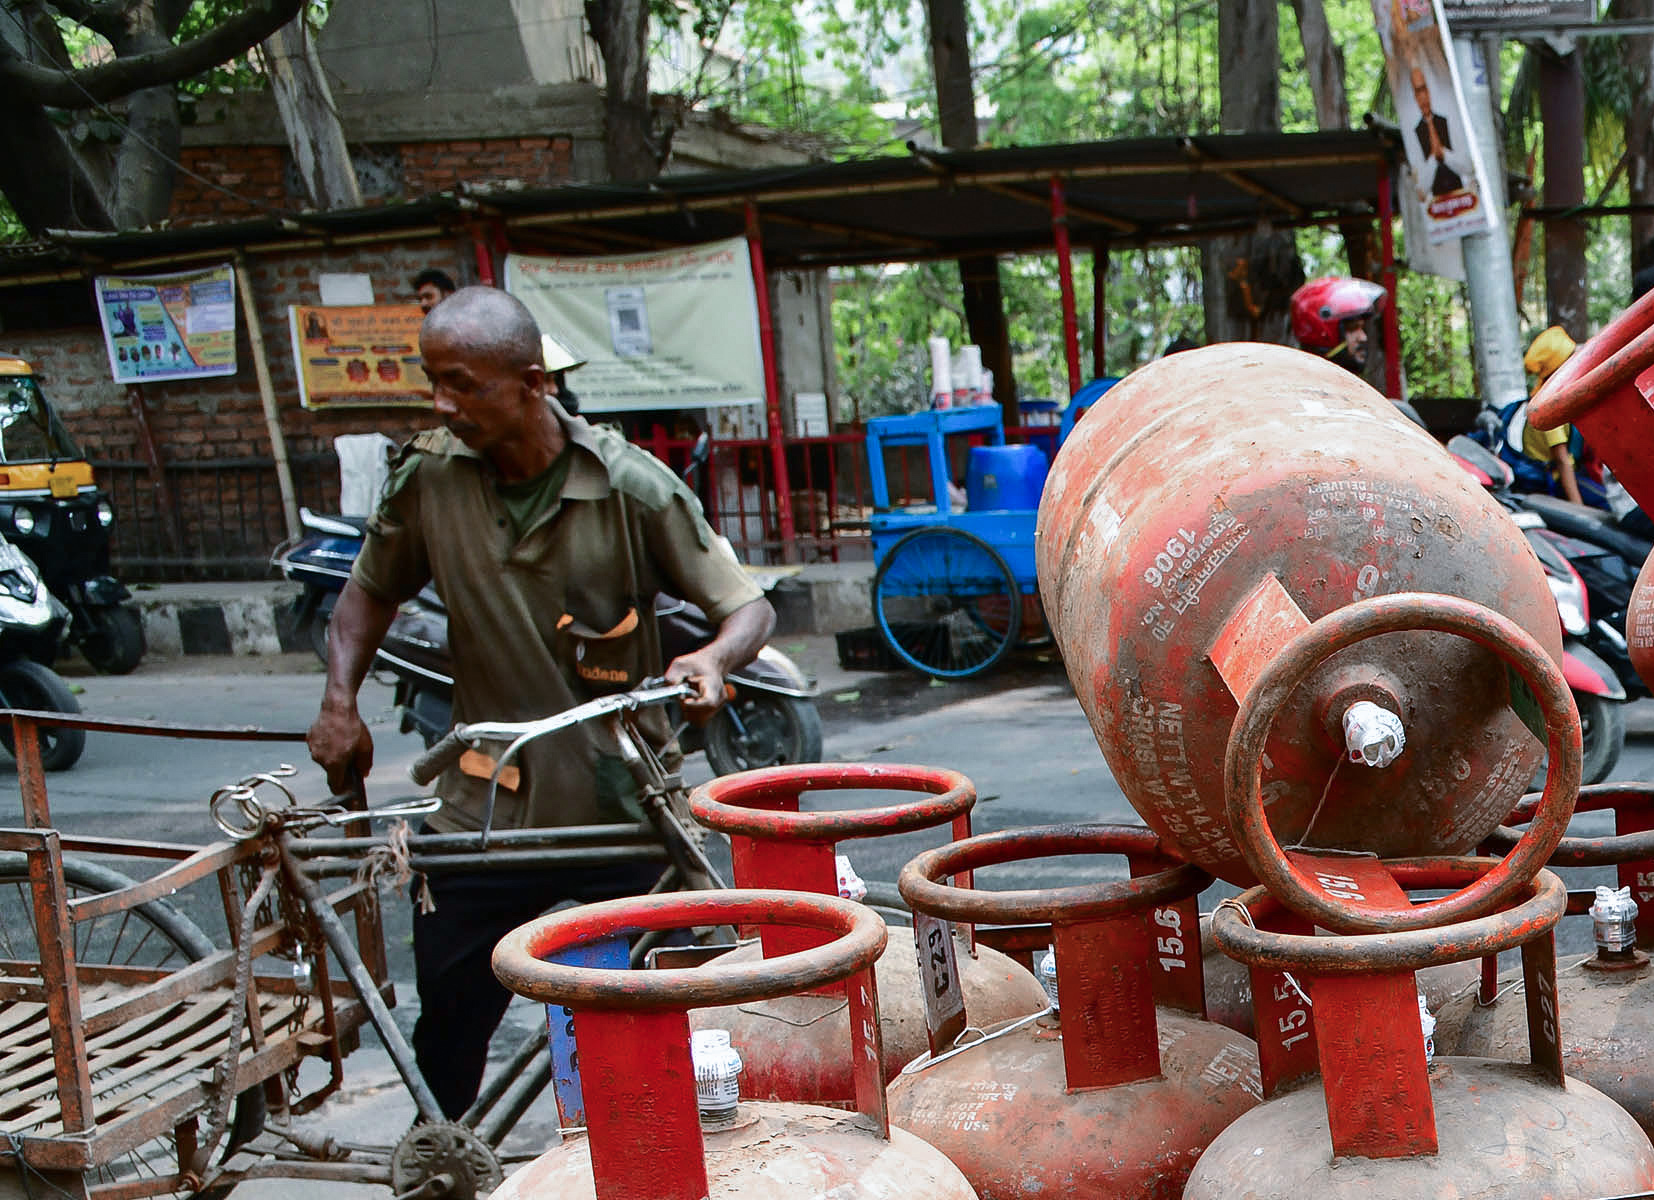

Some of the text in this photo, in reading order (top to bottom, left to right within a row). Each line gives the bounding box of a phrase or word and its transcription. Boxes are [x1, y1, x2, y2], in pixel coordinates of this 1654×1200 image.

[1143, 528, 1197, 588] 1906
[1315, 871, 1366, 901] 15.6
[1154, 906, 1187, 972] 15.6
[1273, 977, 1310, 1052] 15.5
